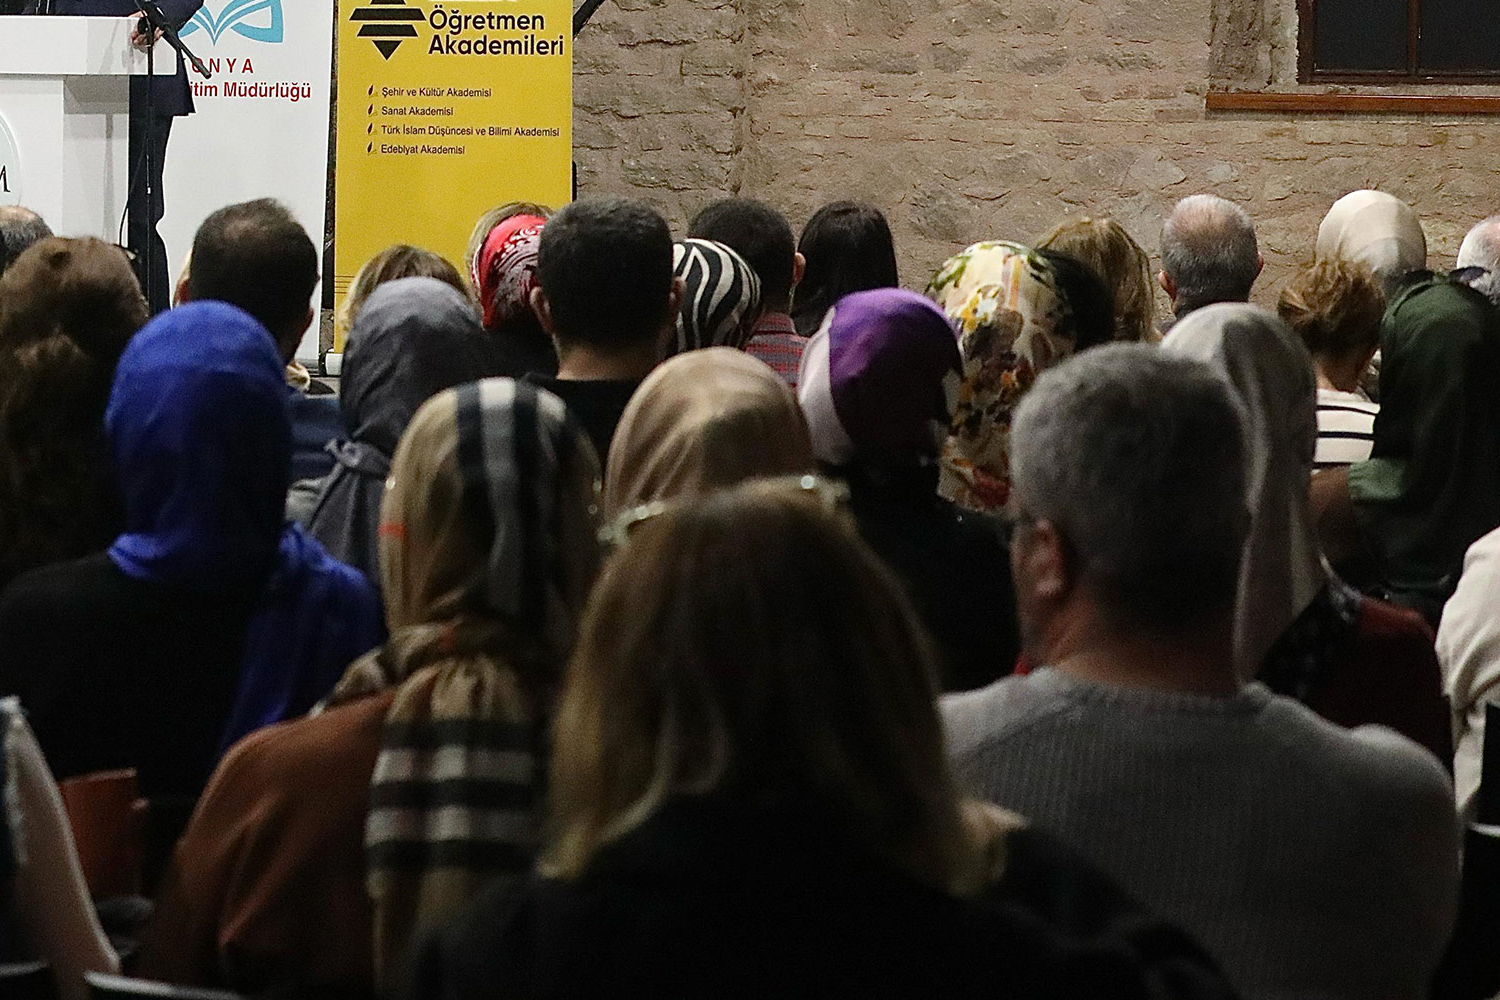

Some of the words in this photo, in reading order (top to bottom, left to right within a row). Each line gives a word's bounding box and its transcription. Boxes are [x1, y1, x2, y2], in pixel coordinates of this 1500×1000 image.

[429, 4, 545, 35] Öğretmen
[428, 34, 564, 56] Akademileri
[223, 81, 311, 102] Müdürlüğü
[381, 86, 405, 99] Şehir
[419, 87, 445, 97] Kültür
[447, 87, 492, 97] Akademisi
[381, 107, 407, 116] Sanat
[408, 107, 454, 116] Akademisi
[381, 125, 401, 135] Türk
[403, 124, 426, 135] İslam
[428, 125, 474, 137] Düşüncesi
[514, 127, 560, 137] Akademisi
[380, 144, 418, 156] Edebiyat
[420, 145, 465, 155] Akademisi
